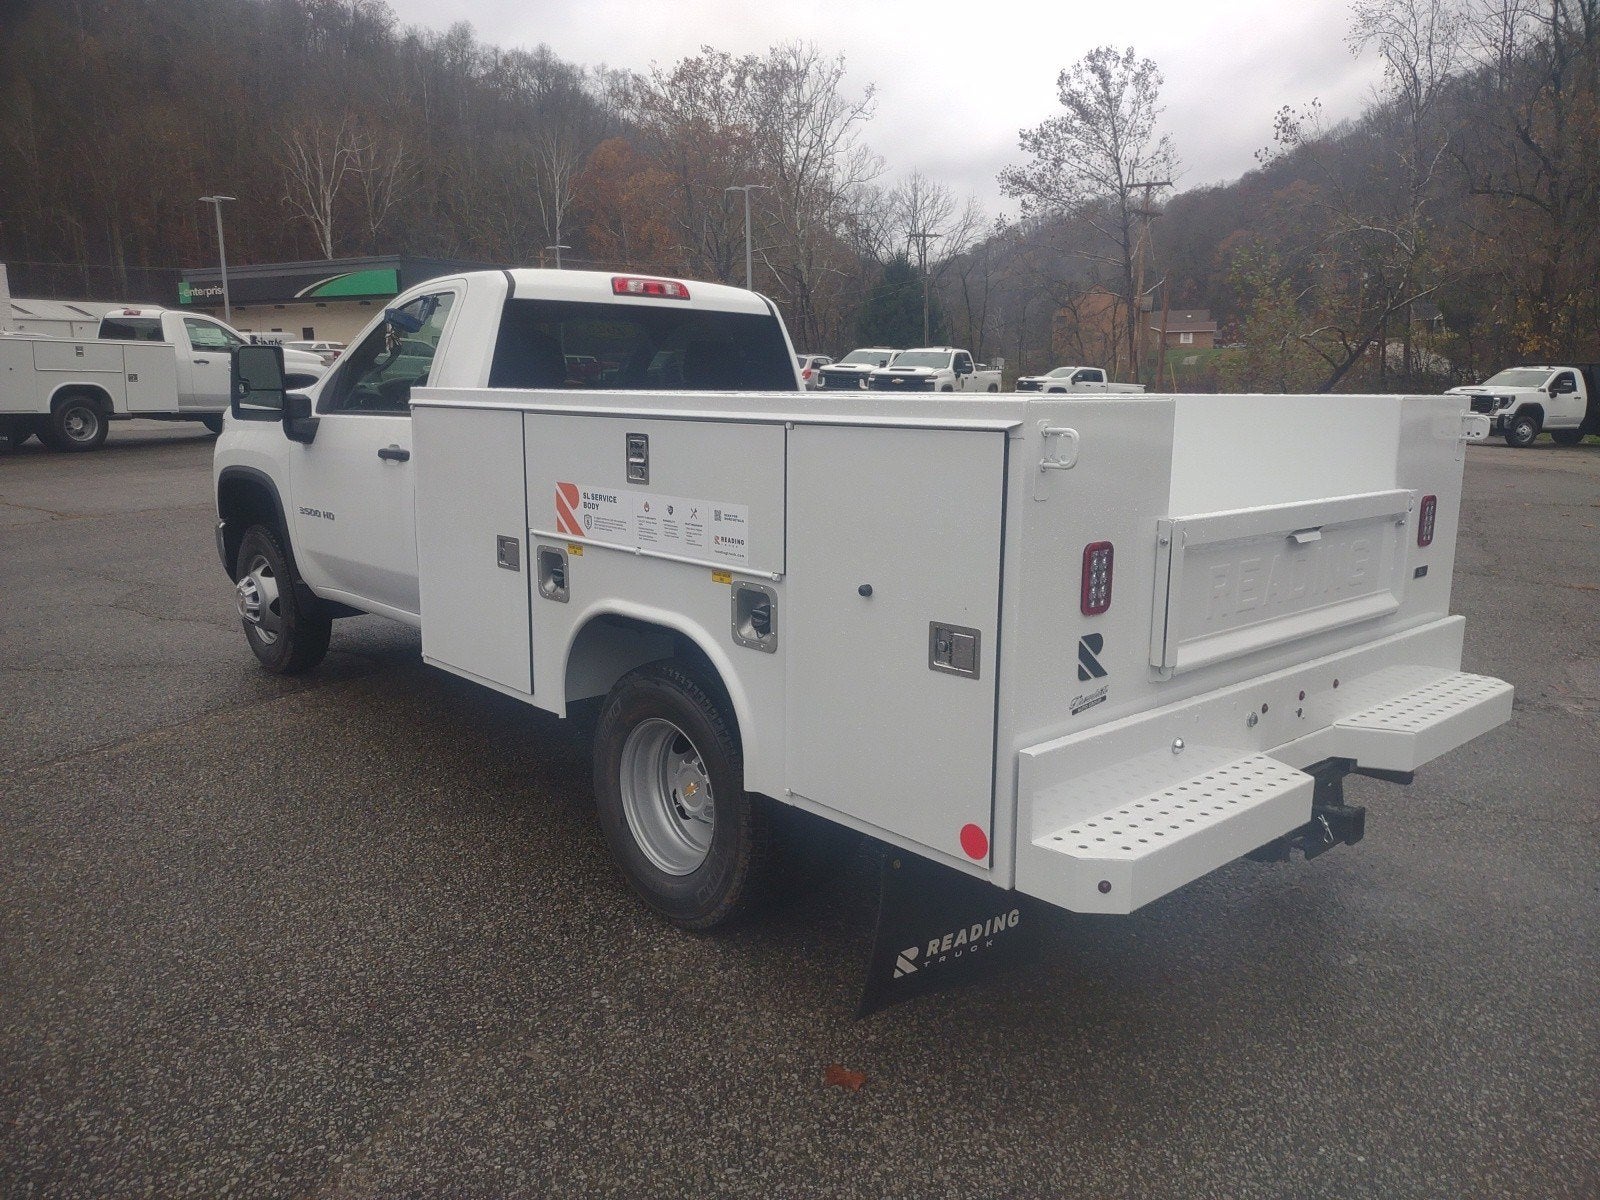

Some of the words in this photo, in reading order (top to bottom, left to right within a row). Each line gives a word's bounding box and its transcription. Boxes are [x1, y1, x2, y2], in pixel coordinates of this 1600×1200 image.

[583, 492, 590, 500] SL
[591, 493, 618, 504] SERVICE
[583, 501, 600, 510] BODY
[322, 510, 336, 521] HD
[926, 909, 1020, 957] READING
[923, 939, 993, 967] TRUCK
